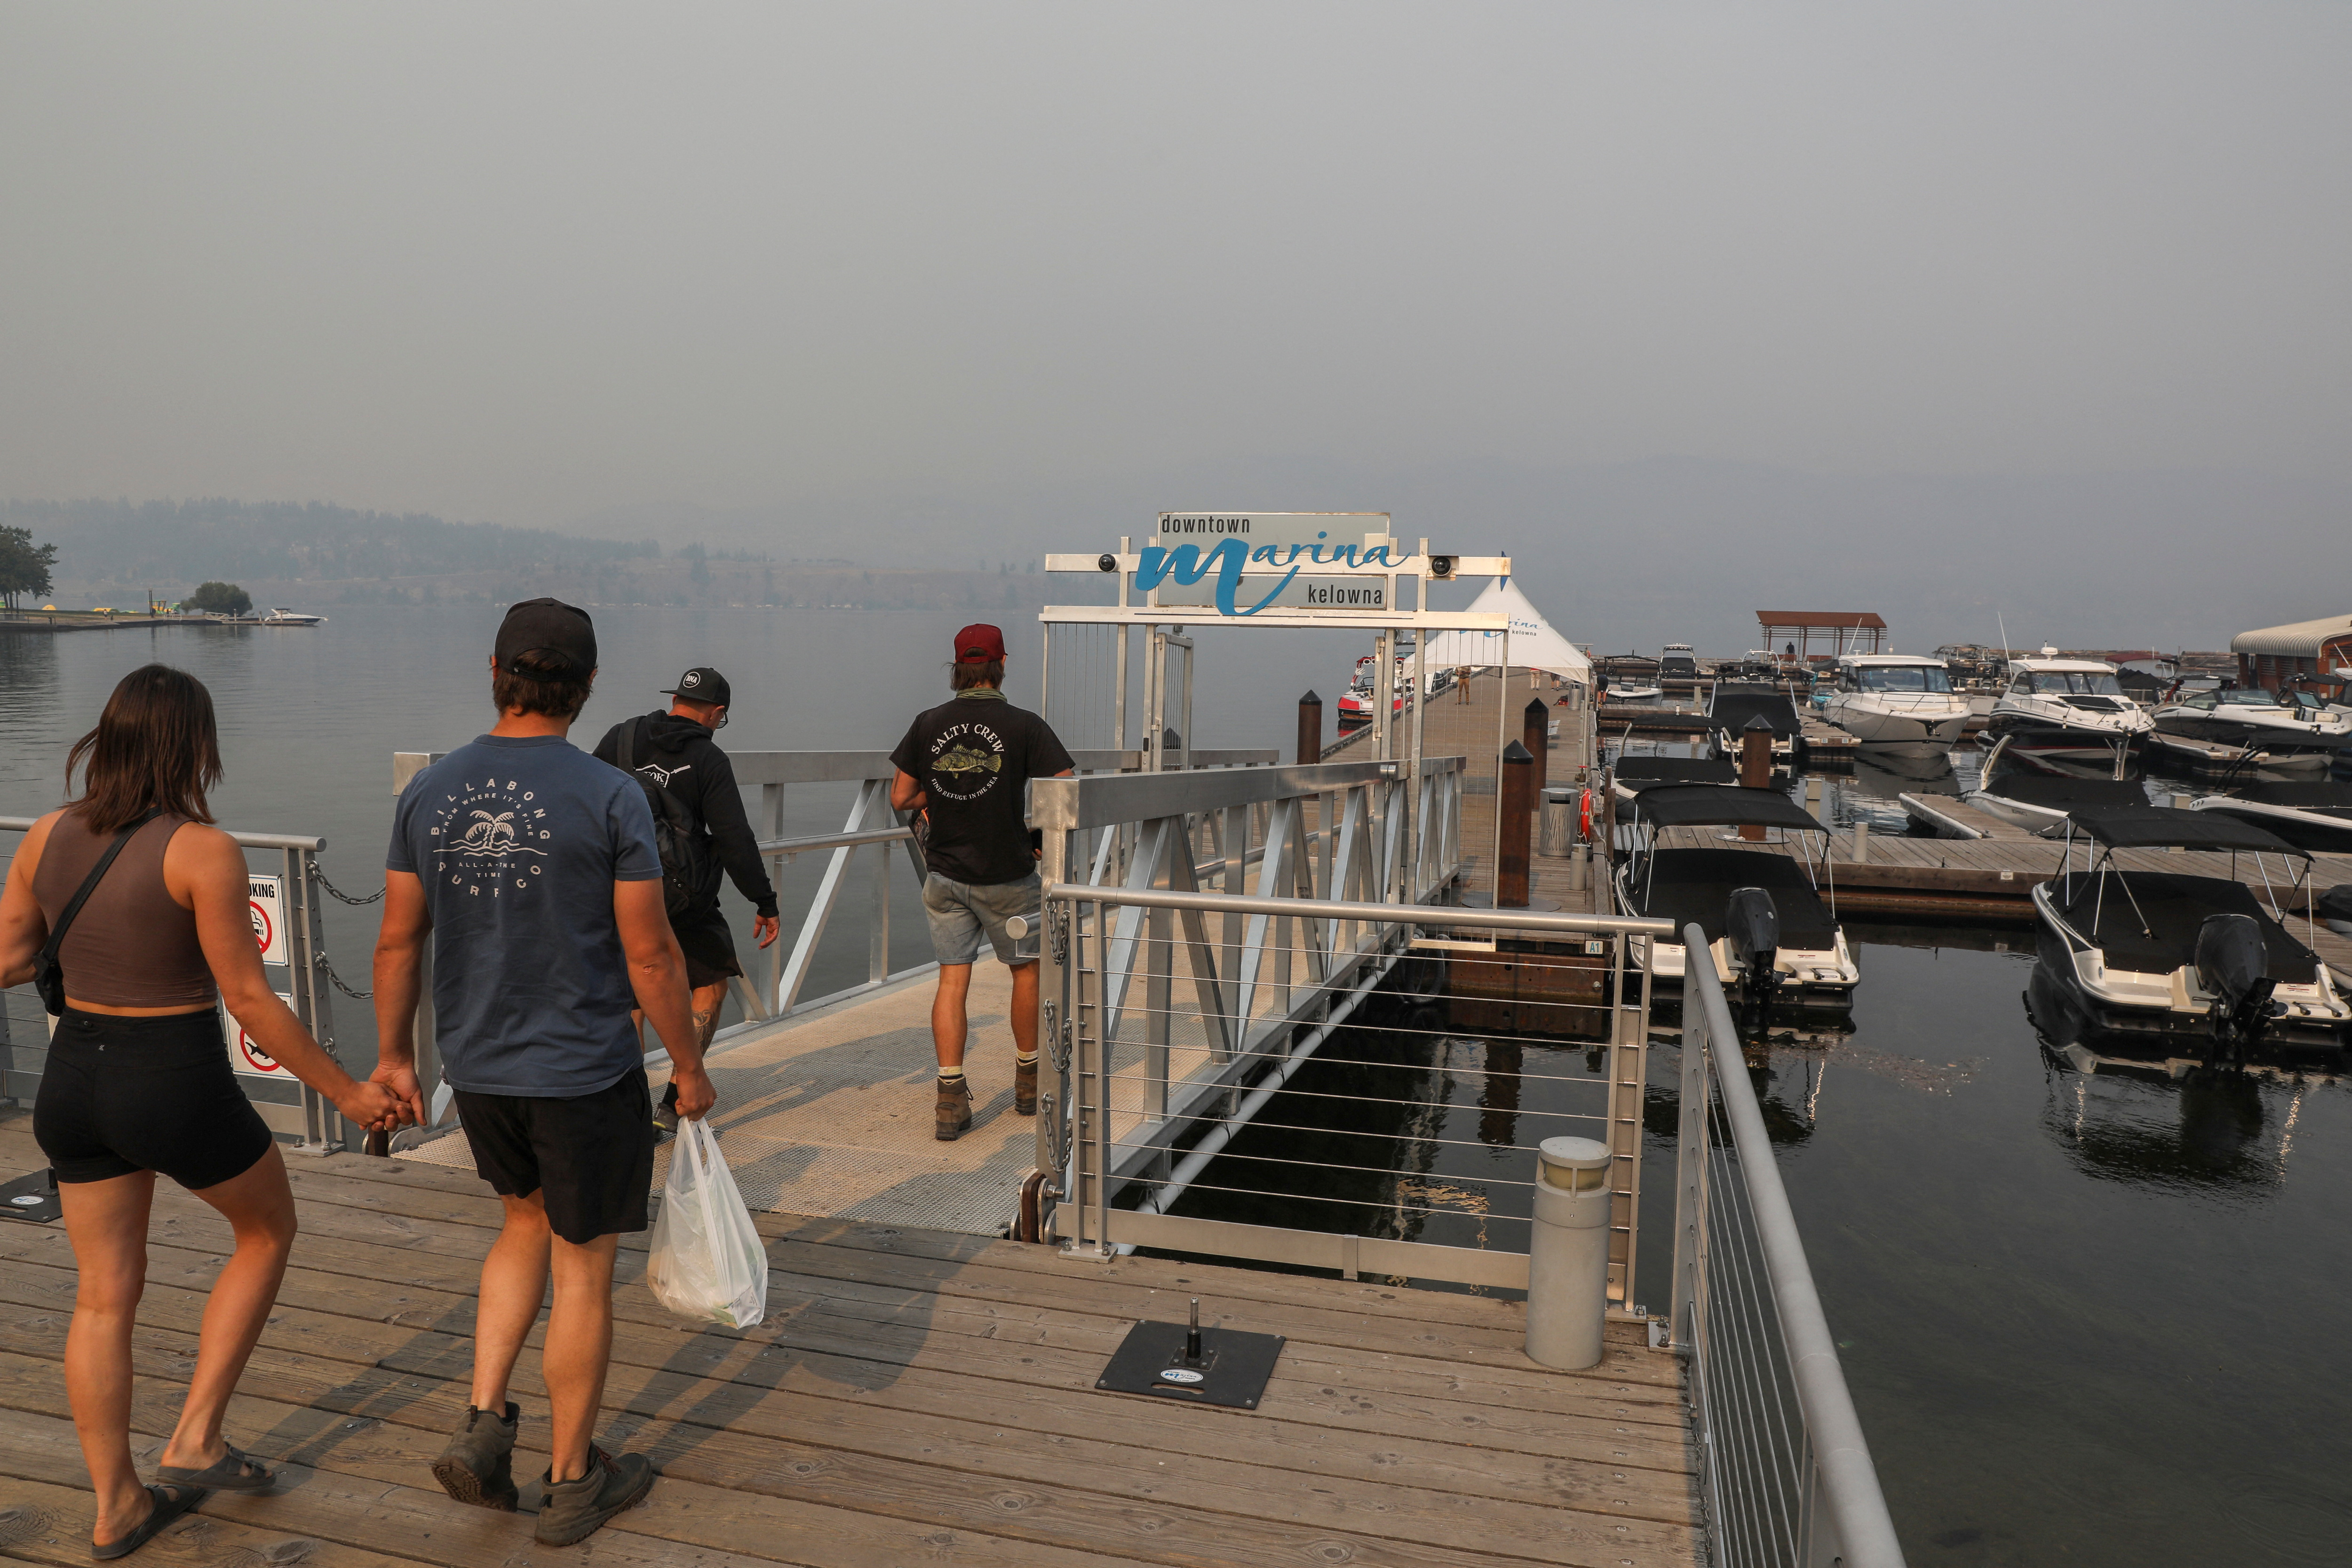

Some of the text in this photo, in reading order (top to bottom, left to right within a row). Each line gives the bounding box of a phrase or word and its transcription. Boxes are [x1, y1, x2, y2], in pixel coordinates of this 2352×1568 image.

[1161, 514, 1250, 533] downtown
[1308, 584, 1383, 605] kelowna
[685, 675, 697, 684] BNA
[931, 723, 1005, 754] SALTY CREW
[931, 778, 943, 793] FIND
[942, 790, 968, 800] REFUGE
[976, 786, 988, 797] THE
[986, 776, 998, 788] SEA
[430, 778, 550, 839] BILLABONG
[443, 793, 533, 836] FROM WHERE IT'S FINE
[249, 883, 275, 898] KING
[438, 861, 541, 898] SURF CO
[1589, 942, 1599, 953] A1
